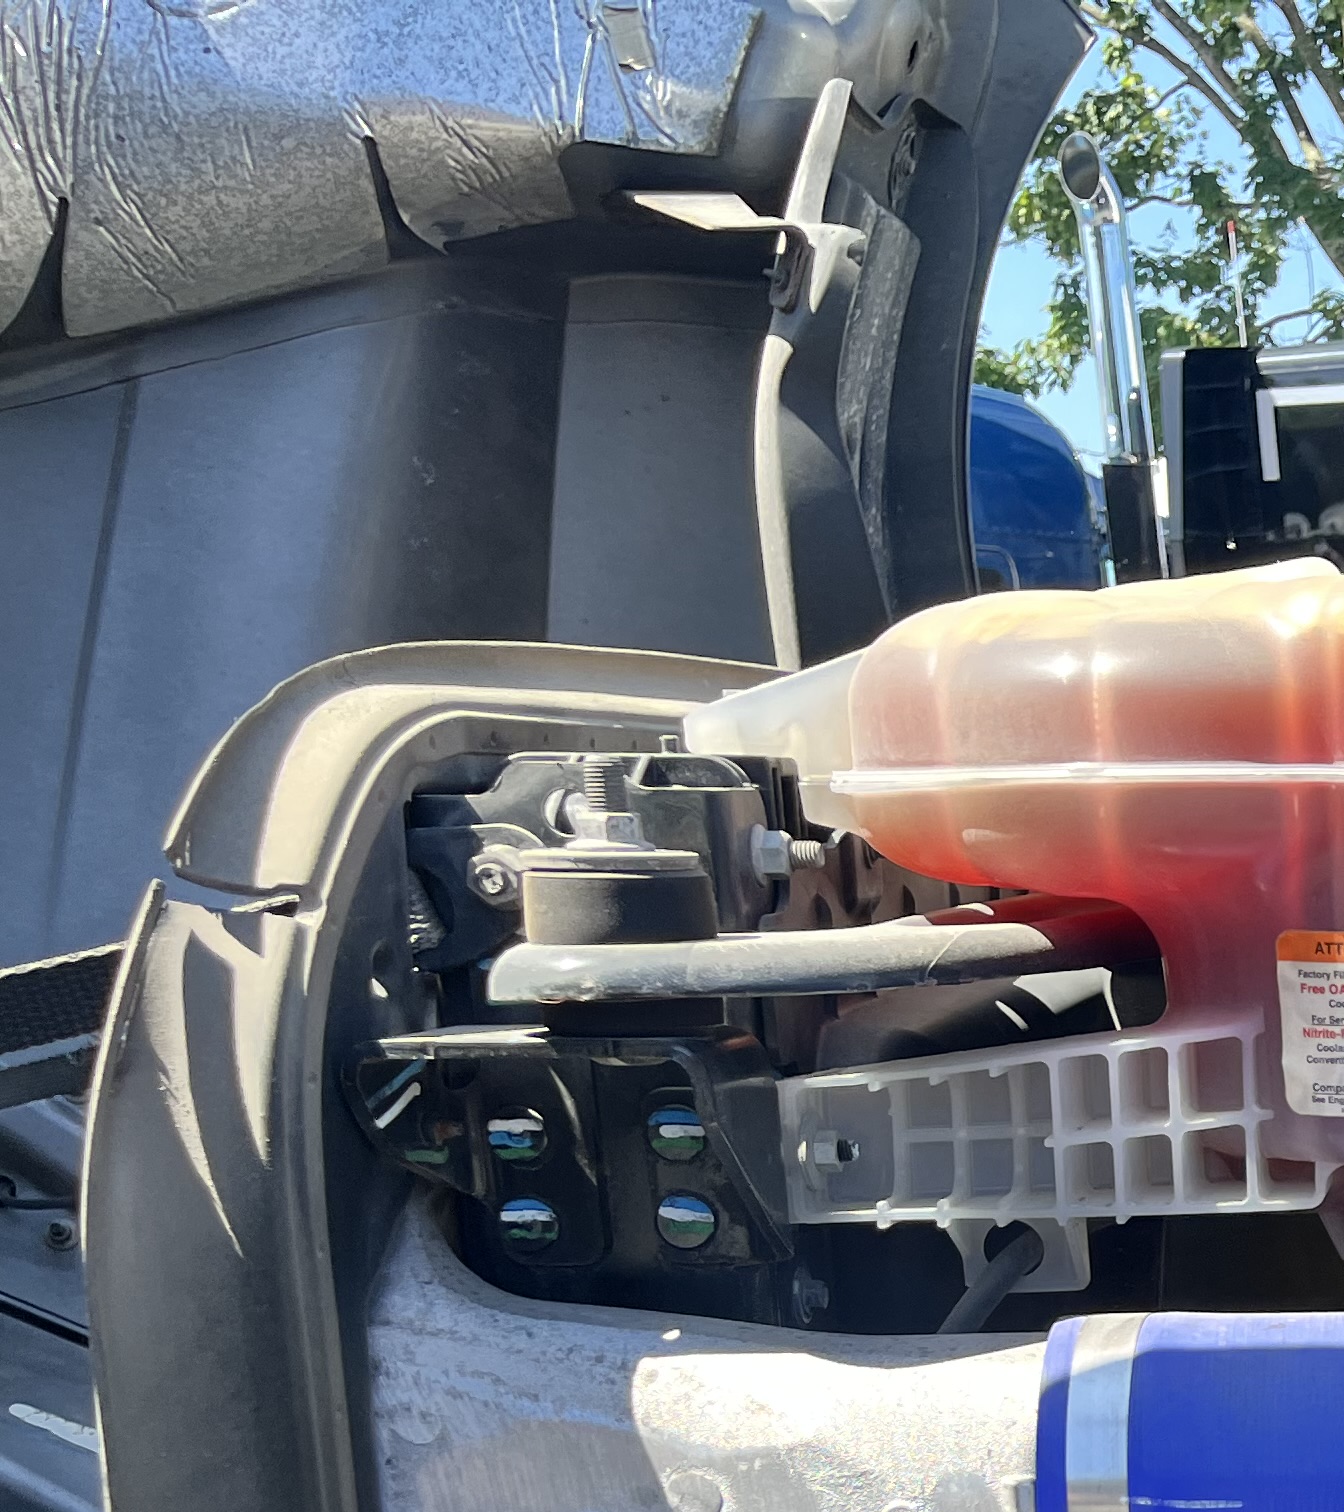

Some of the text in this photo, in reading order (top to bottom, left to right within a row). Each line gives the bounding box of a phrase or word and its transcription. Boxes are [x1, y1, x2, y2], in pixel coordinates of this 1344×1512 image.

[1297, 969, 1331, 981] Factory
[1300, 983, 1326, 994] Free
[1312, 1016, 1326, 1025] For
[1312, 1096, 1325, 1104] See
